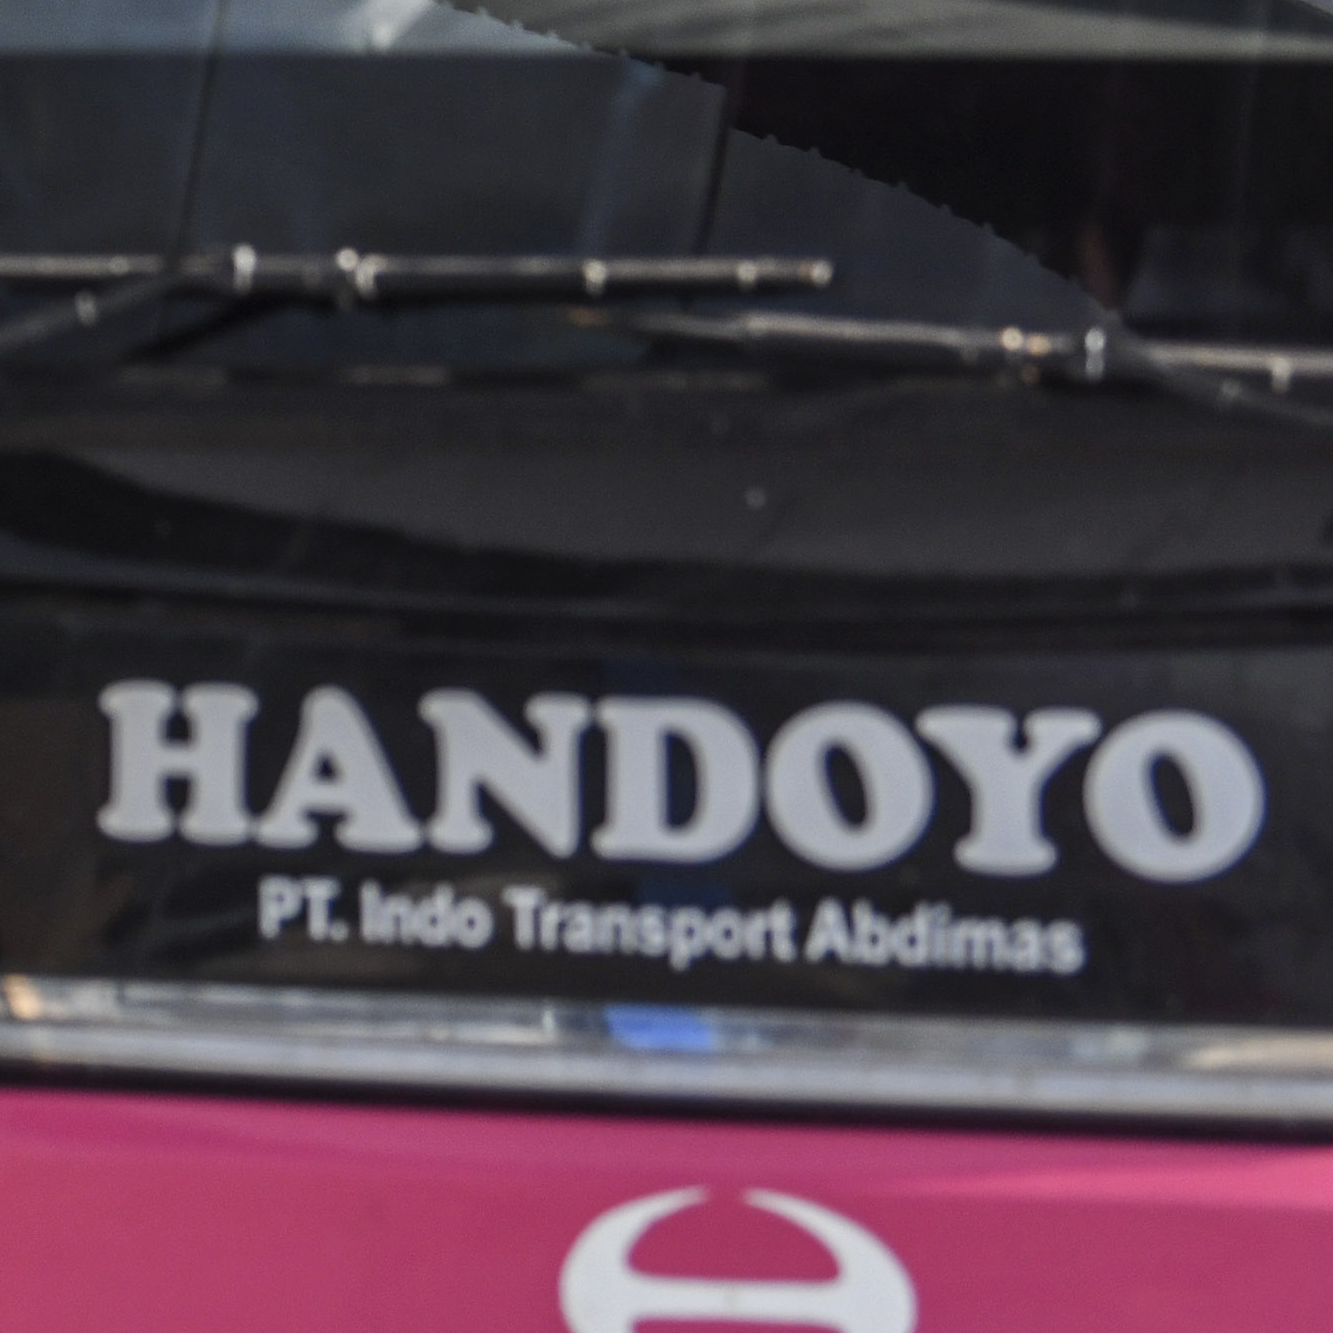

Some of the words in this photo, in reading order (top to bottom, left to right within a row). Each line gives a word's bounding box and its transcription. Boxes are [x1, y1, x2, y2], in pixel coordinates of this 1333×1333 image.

[97, 680, 1266, 883] HANDOYO
[258, 877, 349, 943] PT.
[360, 882, 493, 949] Indo
[504, 887, 797, 973] Transport
[804, 898, 1088, 978] Abdimas
